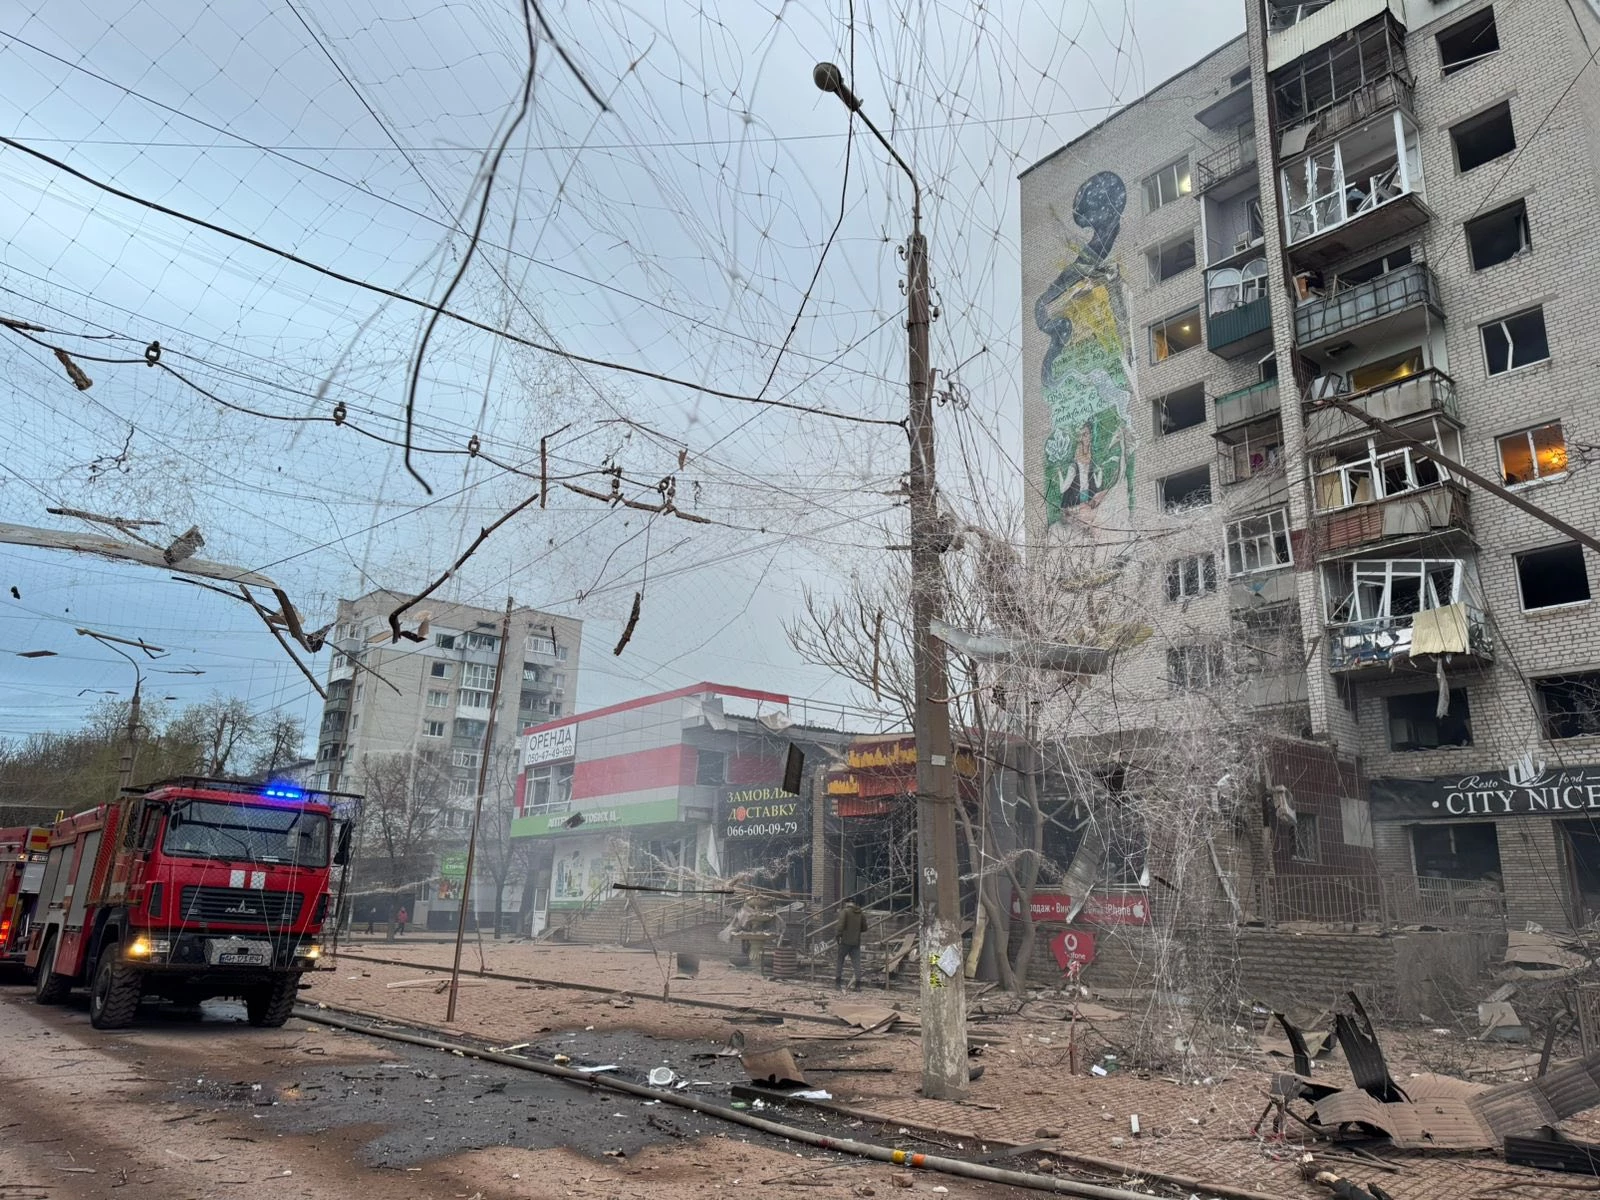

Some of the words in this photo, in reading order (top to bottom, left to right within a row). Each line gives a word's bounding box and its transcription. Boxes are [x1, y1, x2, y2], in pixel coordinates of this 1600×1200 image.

[529, 727, 572, 751] ОРЕНДА
[527, 745, 573, 764] 050-47-49-169
[1457, 775, 1499, 790] Resto
[1558, 770, 1585, 787] food
[1446, 790, 1517, 815] CITY
[1527, 785, 1600, 811] NICE
[727, 822, 798, 837] 066-600-09-79
[1106, 903, 1132, 917] iPhone
